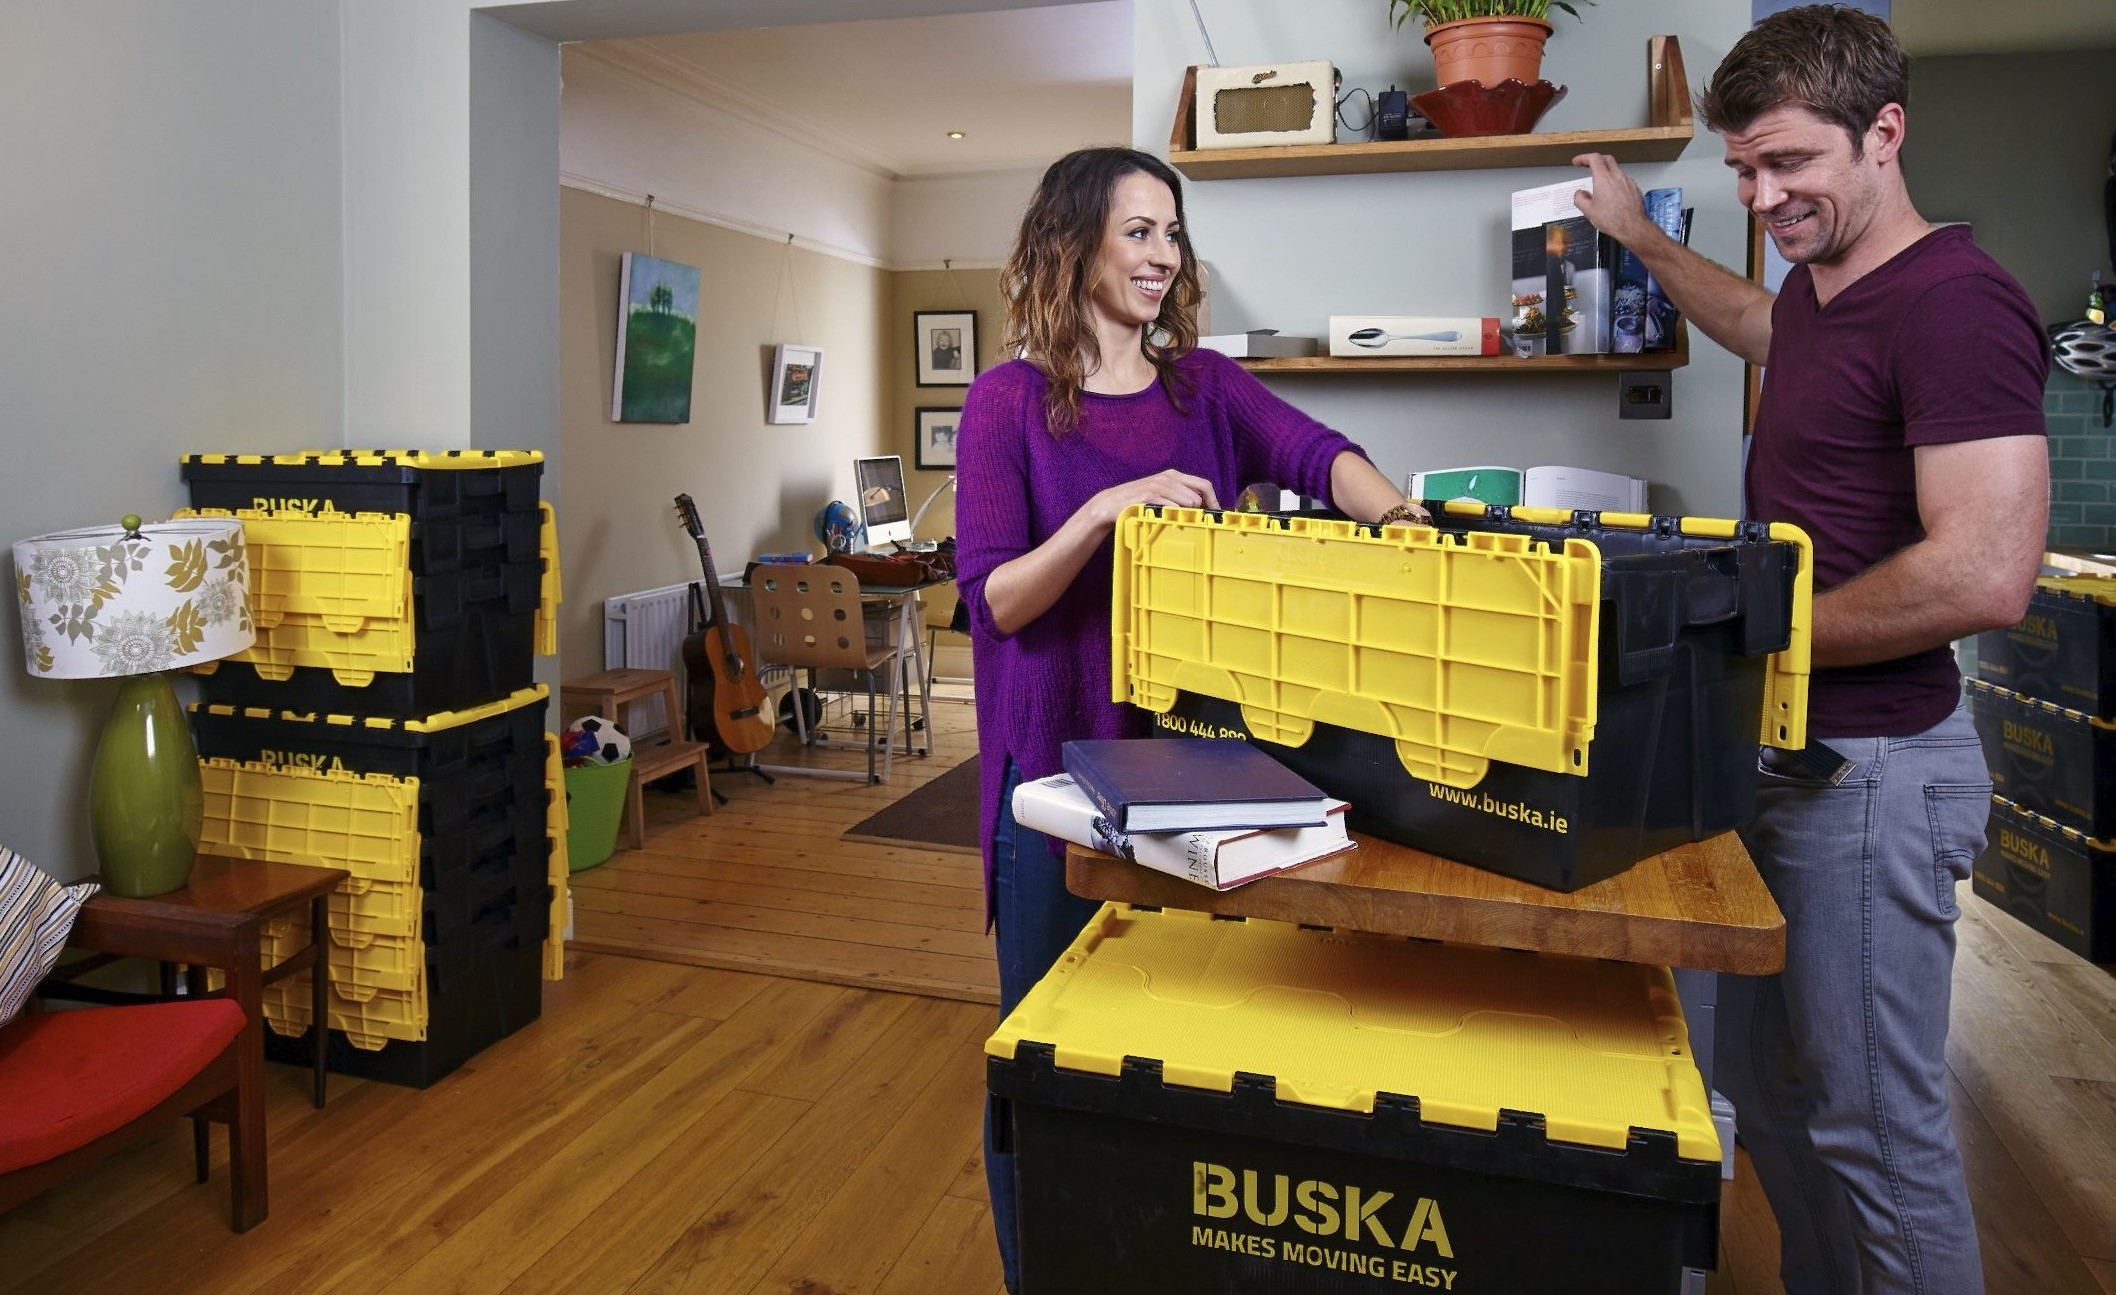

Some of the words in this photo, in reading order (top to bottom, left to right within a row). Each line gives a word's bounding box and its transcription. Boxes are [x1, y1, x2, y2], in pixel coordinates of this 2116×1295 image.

[2010, 613, 2058, 640] USKA
[1154, 712, 1187, 733] 1800
[1189, 719, 1216, 738] 444
[2003, 720, 2053, 755] BUSKA
[1429, 783, 1568, 834] www.buska.ie
[1187, 834, 1203, 881] WINE
[2001, 828, 2049, 869] BUSKA
[1193, 1161, 1455, 1259] BUSKA
[1192, 1226, 1276, 1259] MAKES
[1282, 1242, 1385, 1279] MOVING
[1391, 1260, 1458, 1291] EASY
